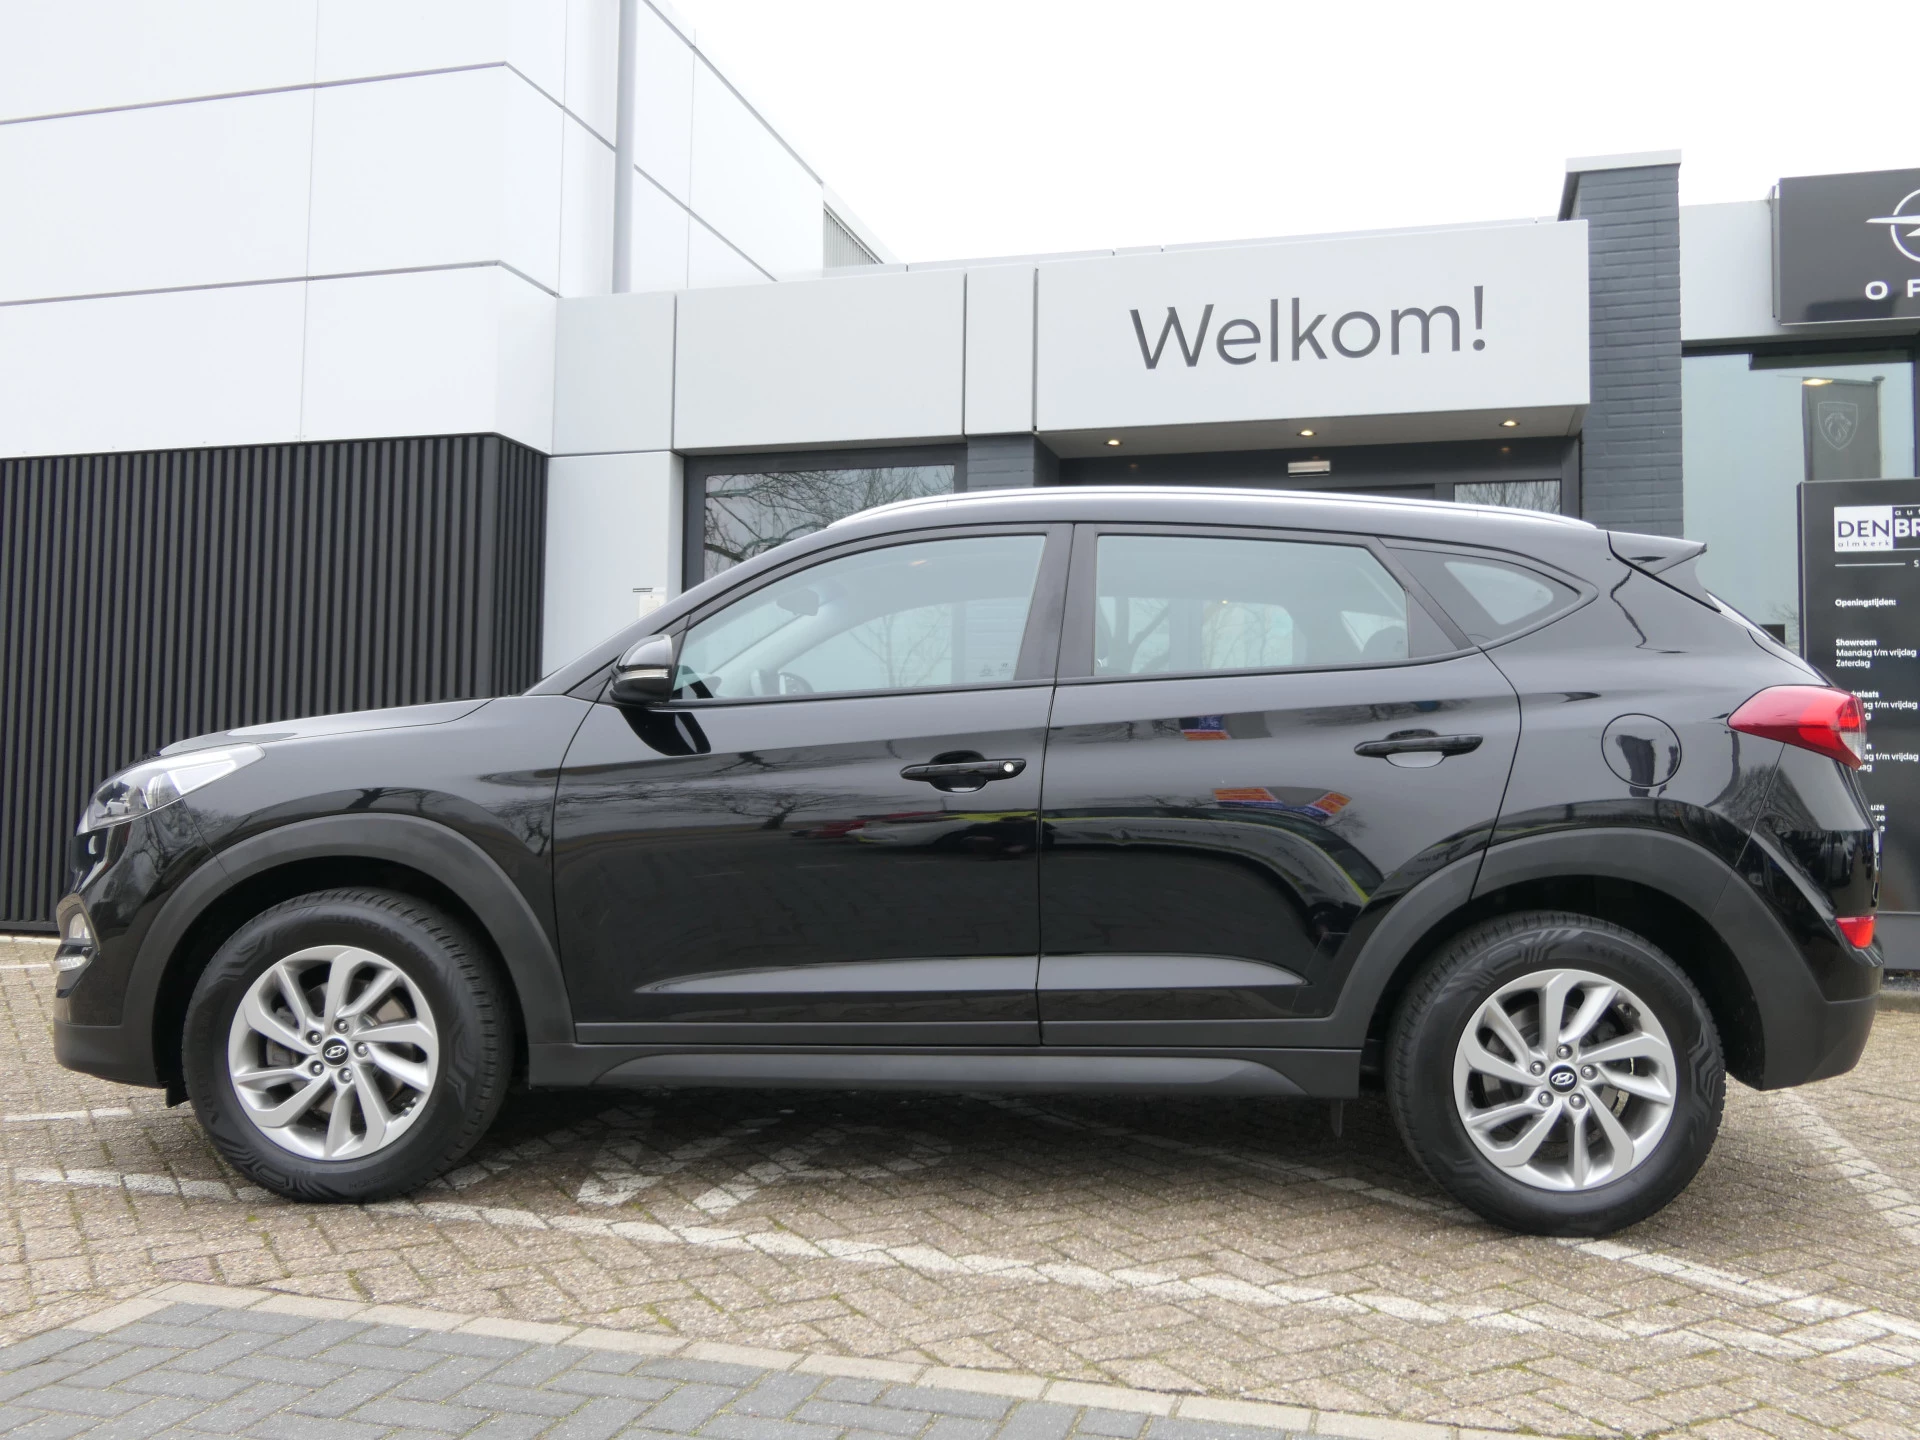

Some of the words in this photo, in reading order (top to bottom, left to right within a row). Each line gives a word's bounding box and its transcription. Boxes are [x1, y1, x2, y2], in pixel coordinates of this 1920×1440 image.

[1129, 285, 1487, 370] Welkom!
[1835, 598, 1897, 608] Openingstijden:
[1836, 638, 1877, 647] Showroom
[1836, 649, 1872, 658] Maandag
[1873, 649, 1888, 657] t/m
[1889, 648, 1917, 658] vrijdag
[1836, 660, 1871, 669] Zaterdag
[1874, 701, 1889, 709] t/m
[1890, 700, 1918, 710] vrijdag
[1891, 752, 1919, 762] vrijdag
